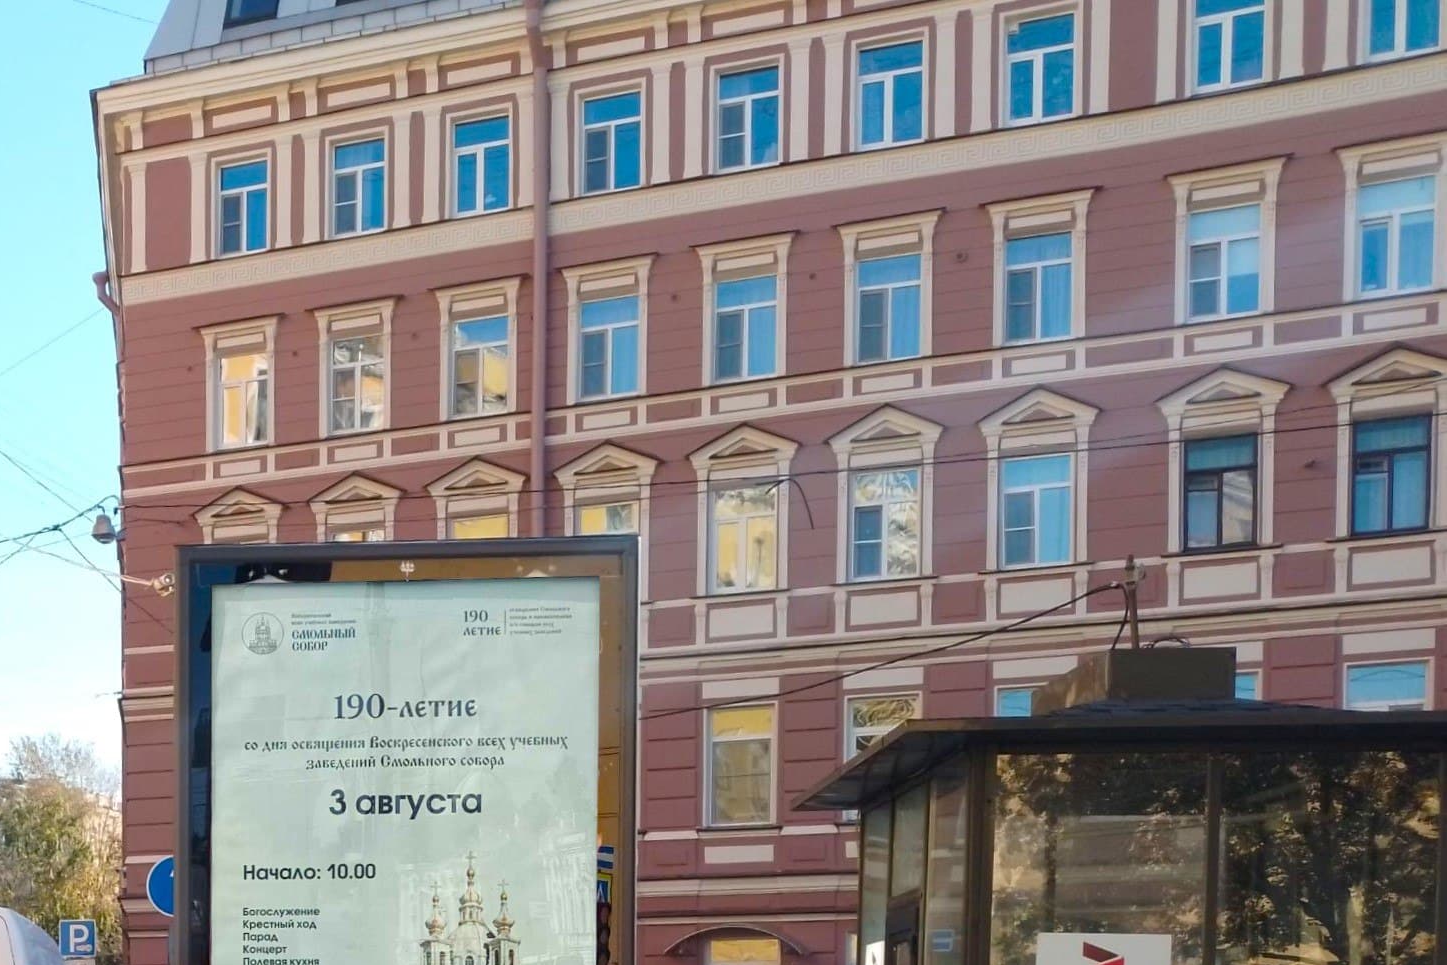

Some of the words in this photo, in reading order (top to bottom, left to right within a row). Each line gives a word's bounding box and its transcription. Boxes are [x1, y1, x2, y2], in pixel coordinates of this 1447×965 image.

[464, 609, 488, 623] 190
[291, 641, 328, 652] СОБОР
[333, 693, 477, 719] 190-летие
[244, 741, 258, 750] со
[262, 741, 287, 752] дня
[291, 738, 365, 752] освящения
[370, 735, 473, 752] Воскресенского
[477, 736, 506, 750] всех
[510, 735, 568, 750] учебных
[305, 755, 376, 770] заведений
[381, 754, 456, 768] Смольного
[460, 756, 505, 770] собора
[328, 788, 347, 815] 3
[356, 793, 482, 820] августа
[243, 864, 321, 880] Начало:
[327, 863, 376, 879] 10.00
[242, 907, 321, 918] Богослужение
[242, 919, 295, 930] Крестный
[296, 921, 317, 930] ход
[69, 924, 89, 953] P
[242, 932, 279, 942] Парад
[242, 945, 288, 955] Концерт
[242, 957, 288, 965] Полевая
